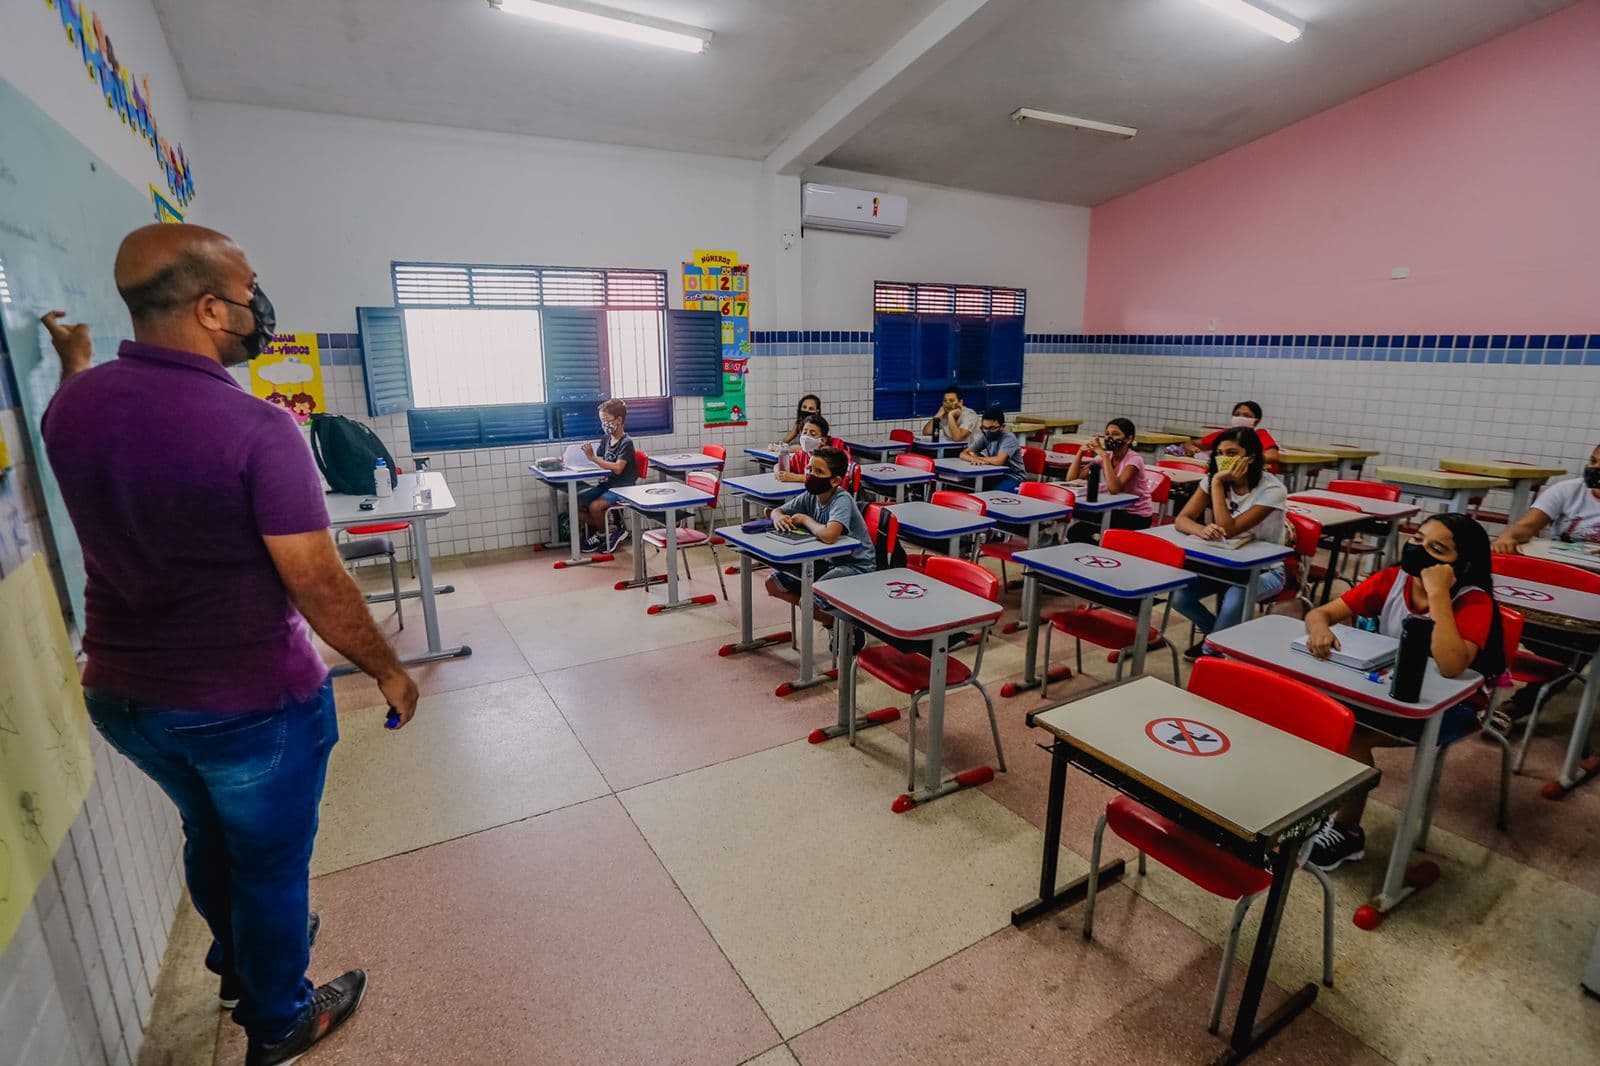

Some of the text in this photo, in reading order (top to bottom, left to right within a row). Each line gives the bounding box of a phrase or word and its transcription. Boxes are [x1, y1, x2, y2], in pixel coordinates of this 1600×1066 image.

[720, 276, 730, 290] 2
[736, 276, 744, 290] 3
[721, 301, 730, 316] 6
[737, 302, 747, 316] 7
